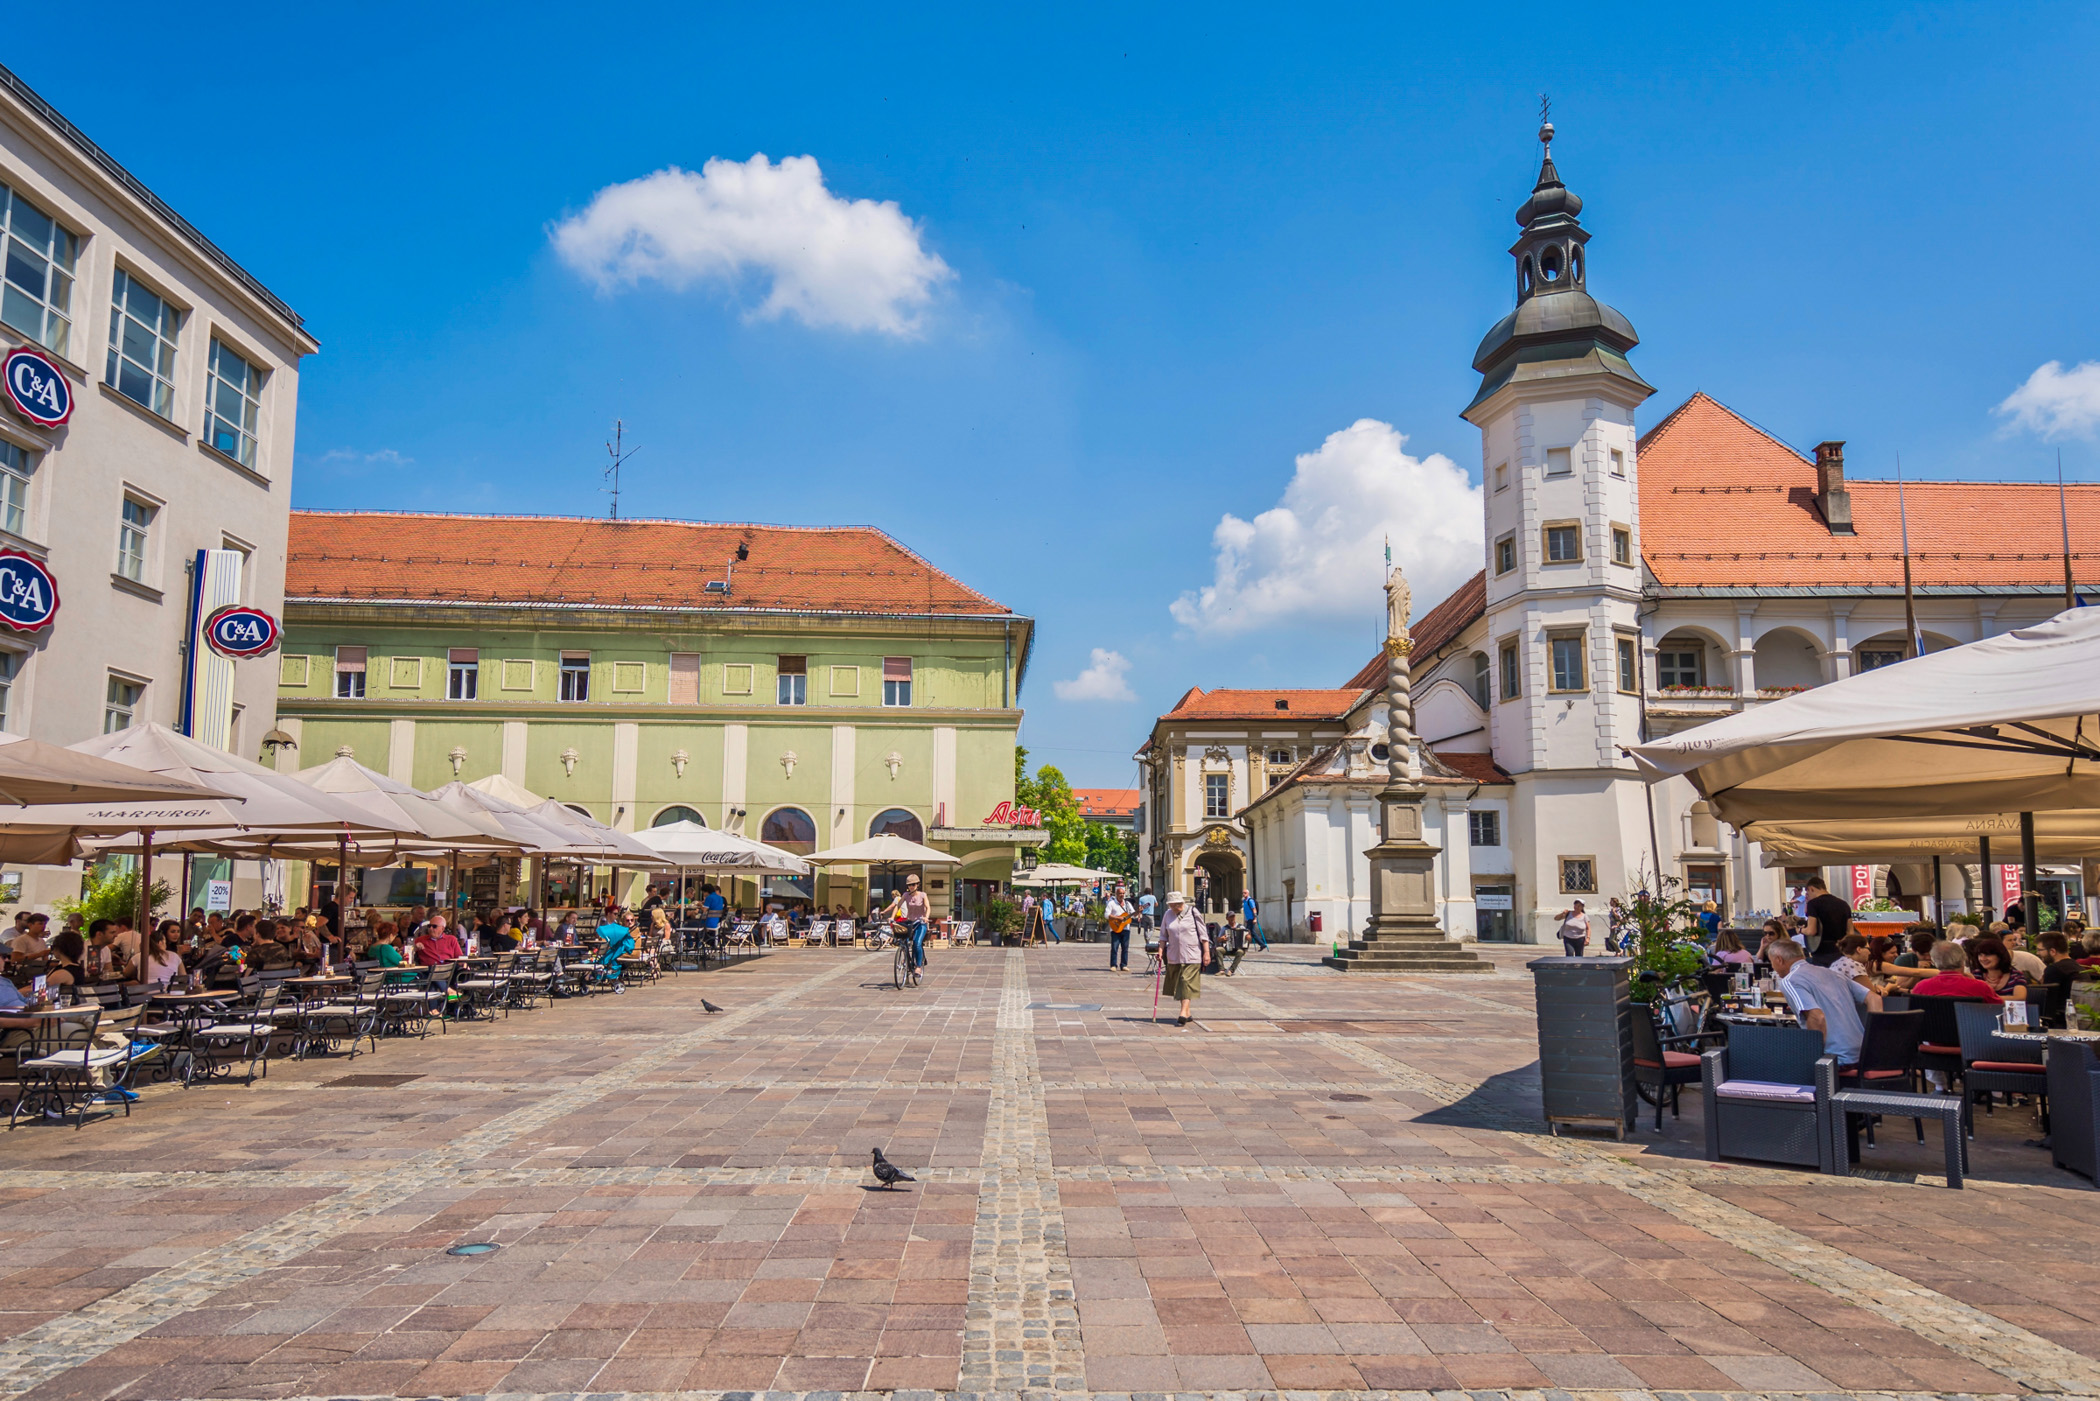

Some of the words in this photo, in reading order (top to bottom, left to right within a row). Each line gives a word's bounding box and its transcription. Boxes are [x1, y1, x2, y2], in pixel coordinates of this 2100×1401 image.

[15, 363, 61, 413] C&A
[0, 568, 46, 614] C&A
[221, 620, 263, 642] C&A
[701, 851, 740, 864] Coca-Cola
[211, 885, 229, 896] -20%
